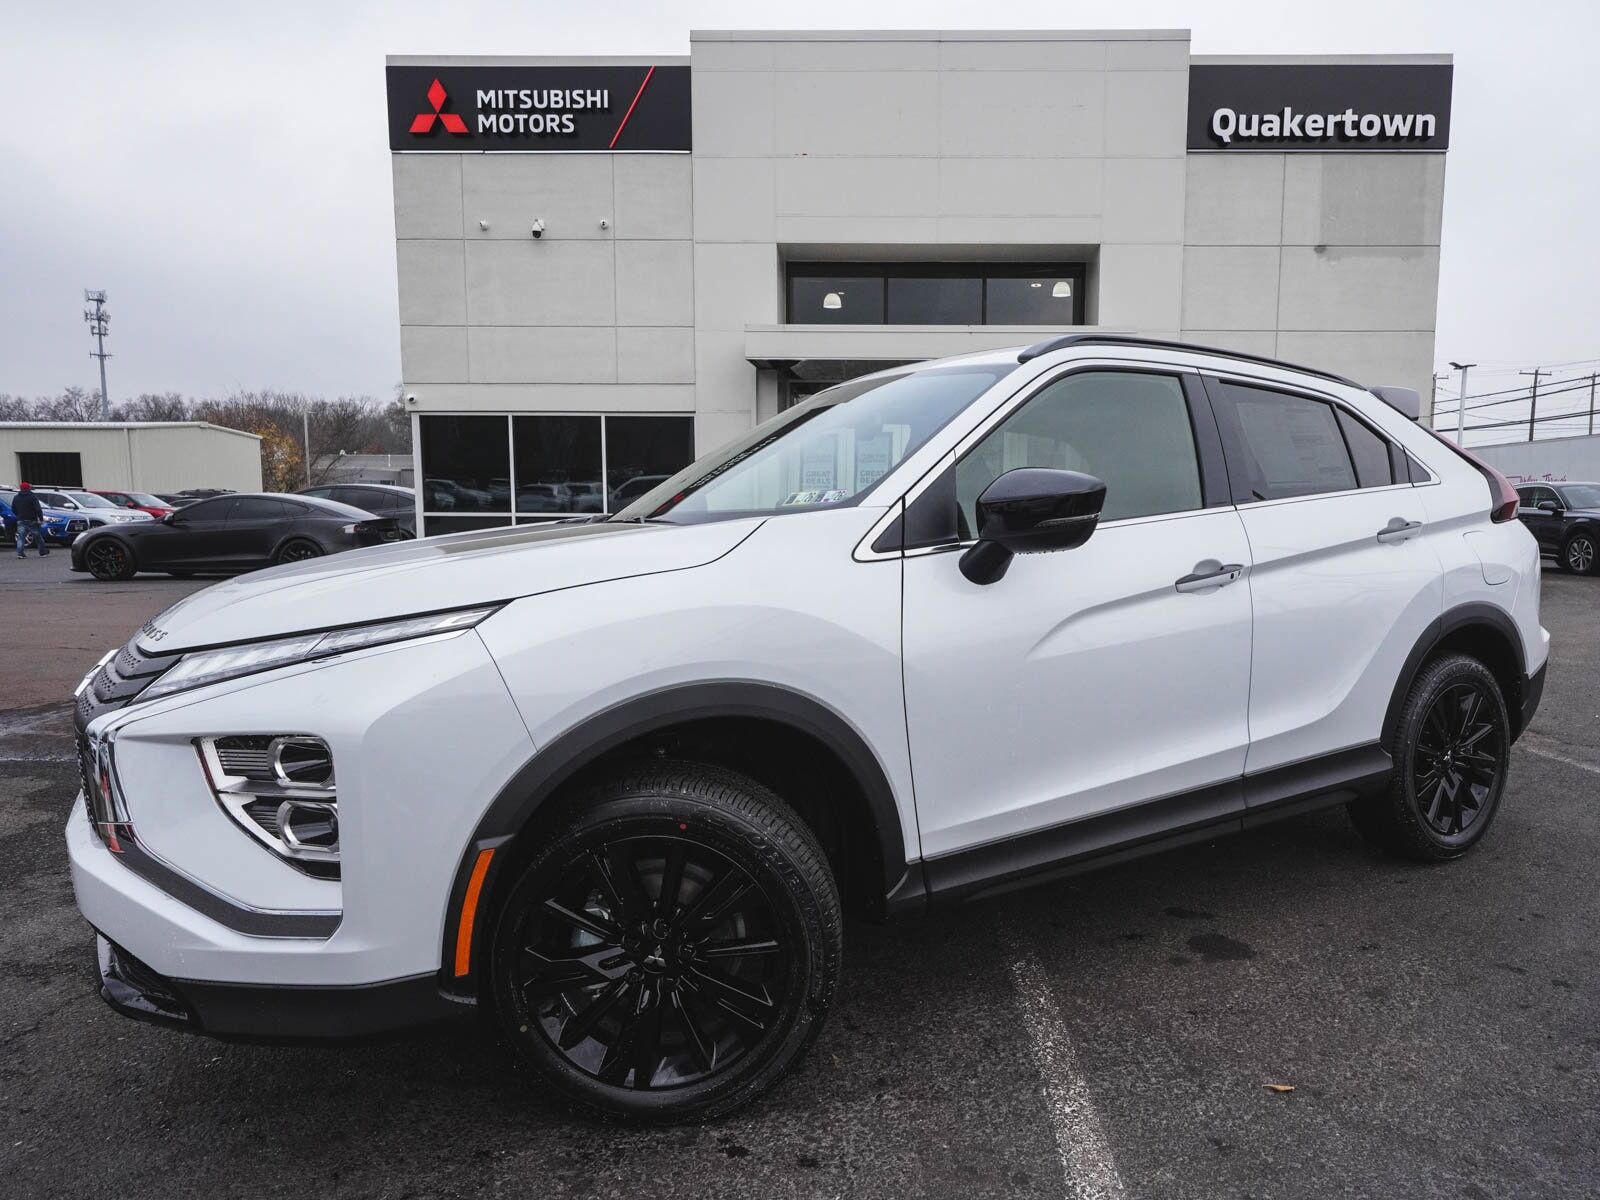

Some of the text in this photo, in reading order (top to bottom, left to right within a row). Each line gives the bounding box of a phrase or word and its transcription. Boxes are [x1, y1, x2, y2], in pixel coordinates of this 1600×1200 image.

[476, 89, 609, 109] MITSUBISHI
[477, 114, 575, 134] MOTORS
[1212, 107, 1437, 143] Quakertown
